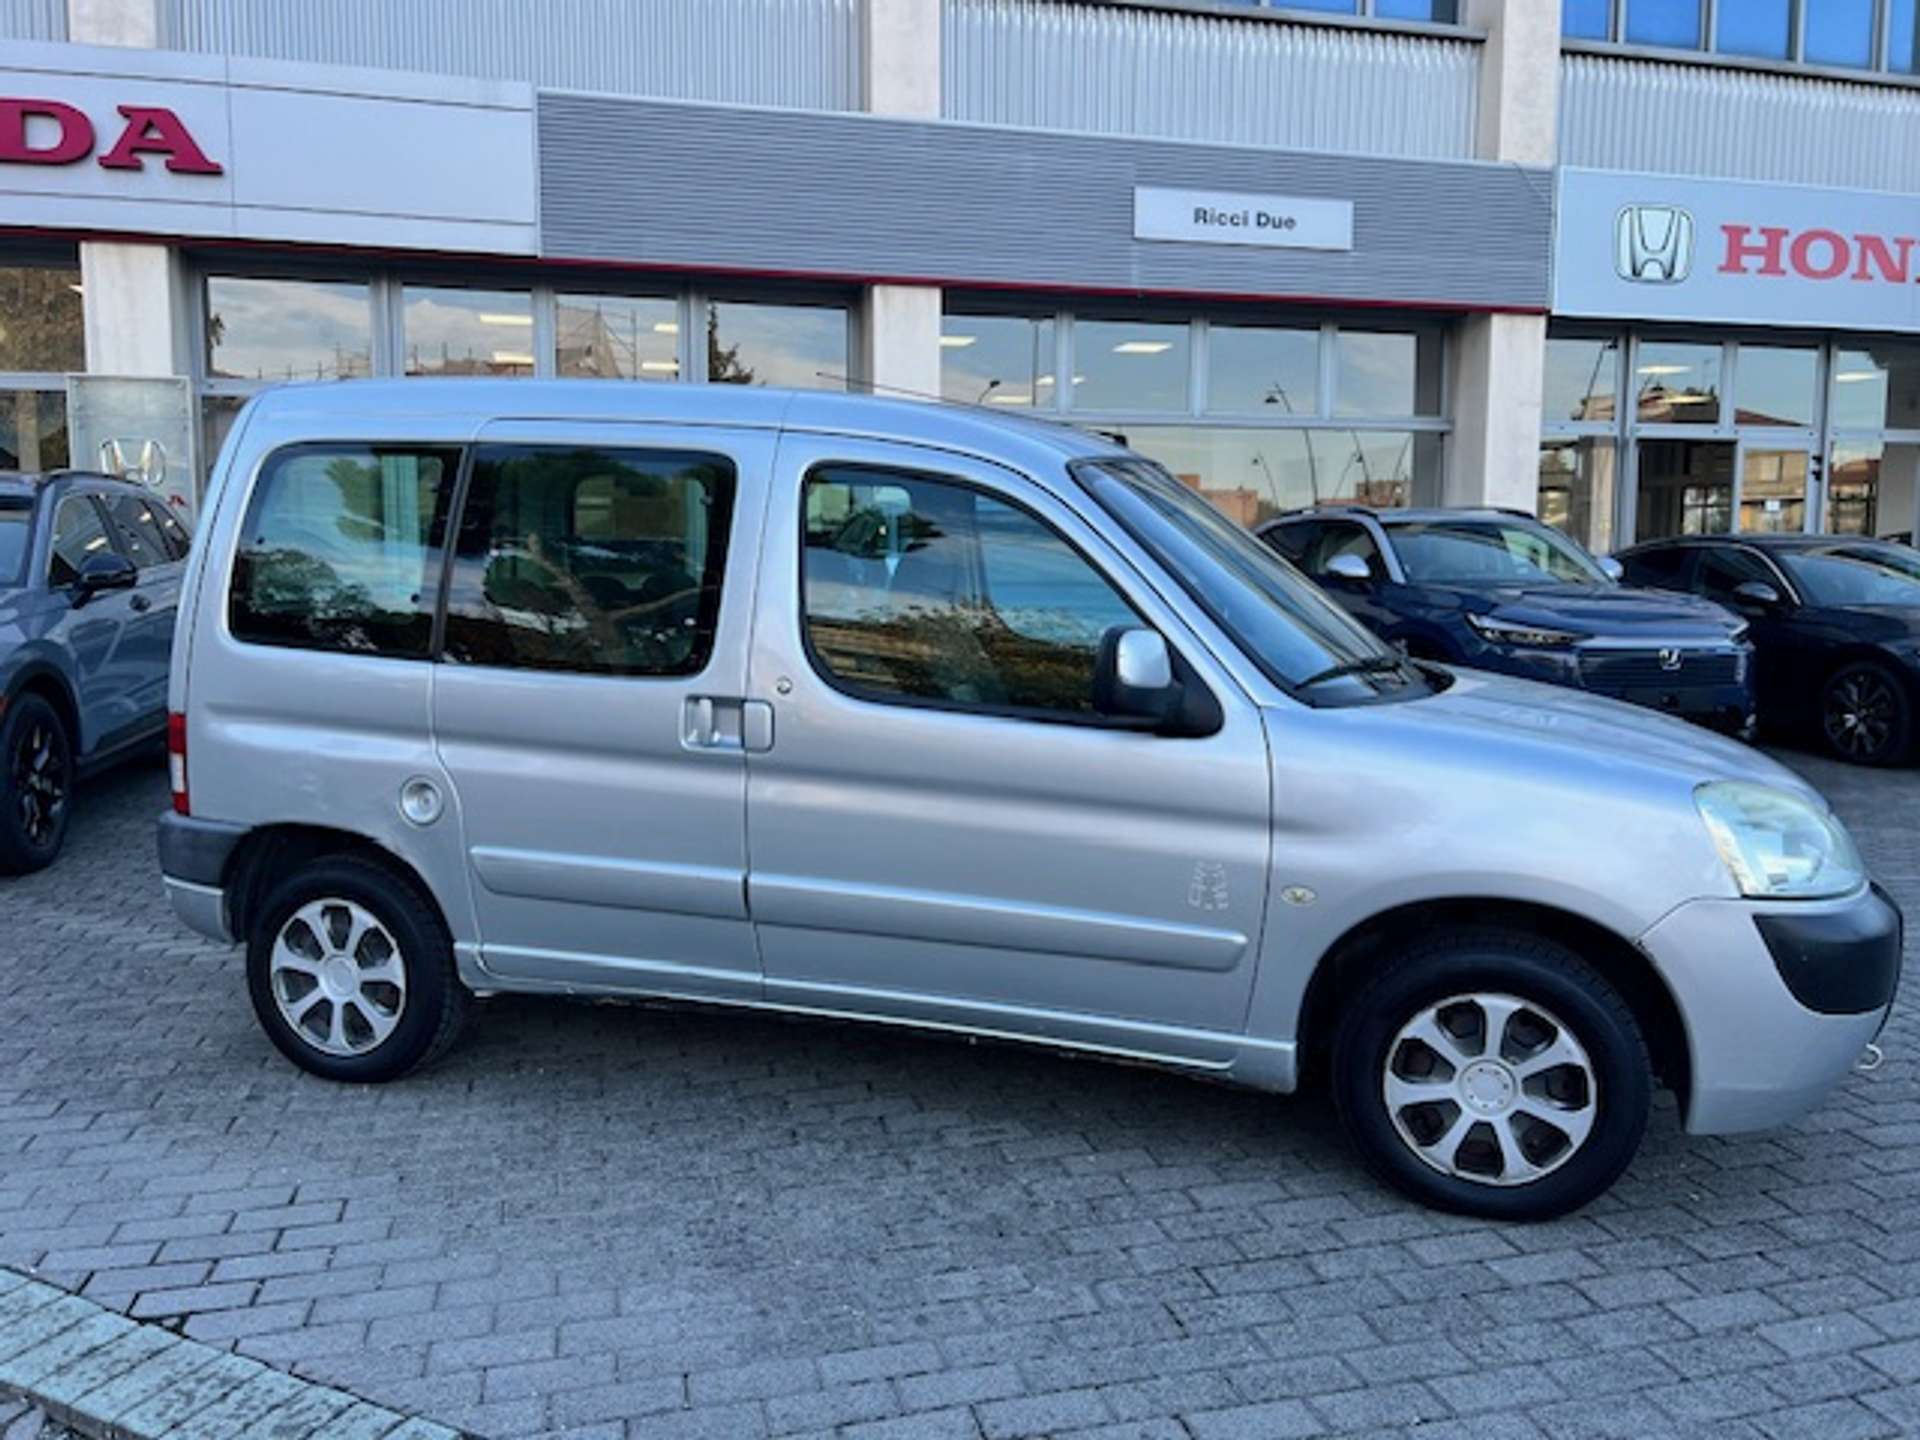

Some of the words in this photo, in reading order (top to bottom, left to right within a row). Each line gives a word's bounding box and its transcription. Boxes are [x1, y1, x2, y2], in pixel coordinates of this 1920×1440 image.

[1194, 207, 1248, 226] Ricci
[1257, 212, 1296, 230] Due
[1717, 224, 1920, 283] HON
